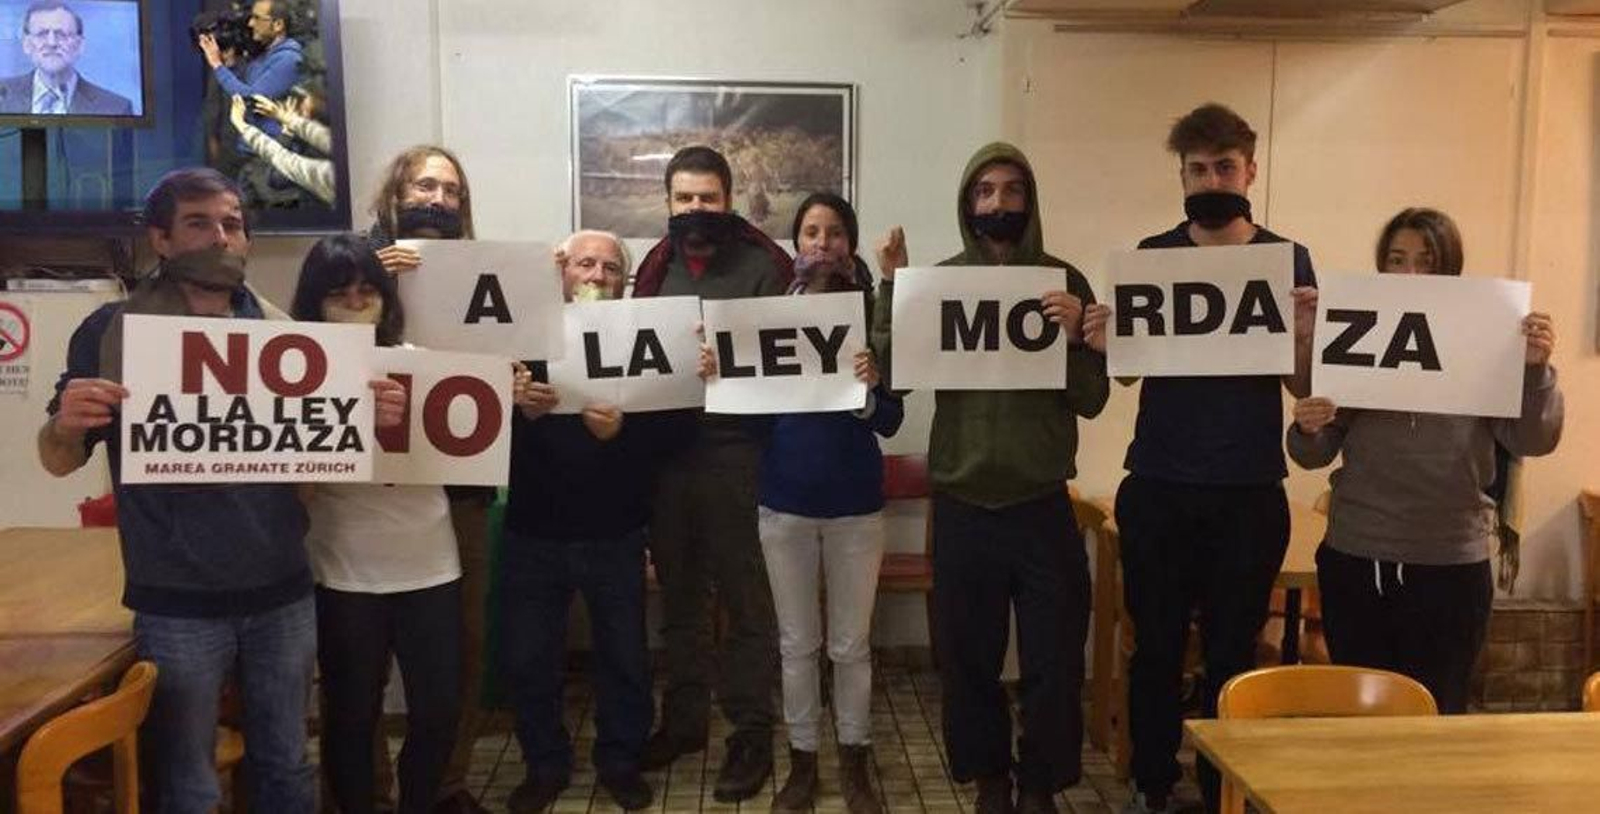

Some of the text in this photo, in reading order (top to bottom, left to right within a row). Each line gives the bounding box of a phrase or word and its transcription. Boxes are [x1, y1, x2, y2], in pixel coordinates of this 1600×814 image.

[464, 273, 513, 324] A
[1114, 280, 1287, 337] RDA
[715, 325, 850, 378] LEY
[941, 299, 1060, 352] MO
[1321, 309, 1442, 371] ZA
[181, 331, 328, 397] NO
[583, 328, 673, 379] LA
[146, 394, 359, 425] A LA LEY
[130, 423, 364, 453] MORDAZA
[145, 463, 206, 474] MAREA
[211, 463, 290, 474] GRANATE
